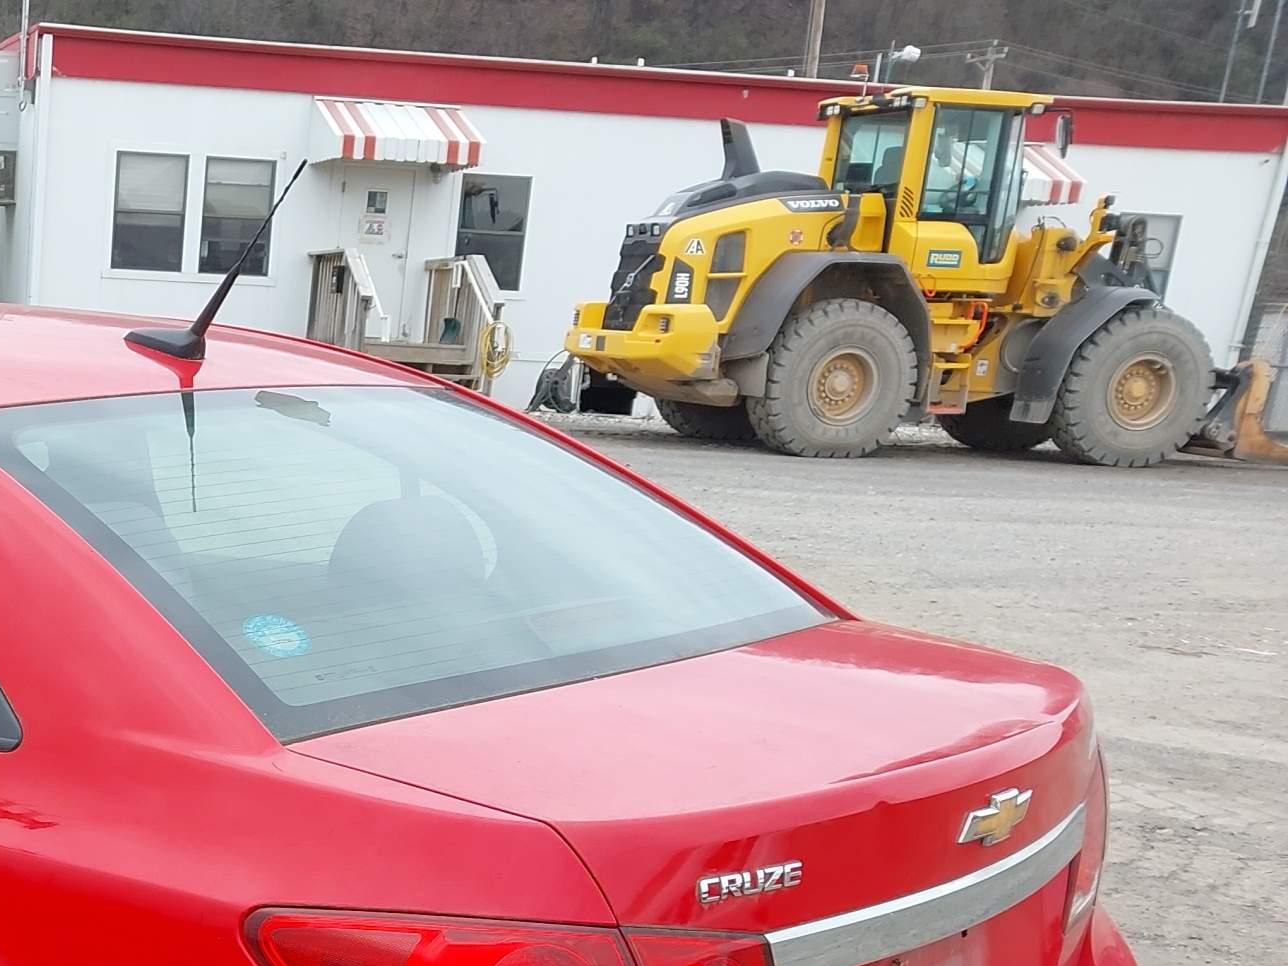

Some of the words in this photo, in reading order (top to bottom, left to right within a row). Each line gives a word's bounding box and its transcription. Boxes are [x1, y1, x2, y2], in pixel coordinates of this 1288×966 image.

[787, 199, 840, 208] VOLVO
[674, 272, 690, 298] L90H
[698, 860, 804, 903] CRUZE
